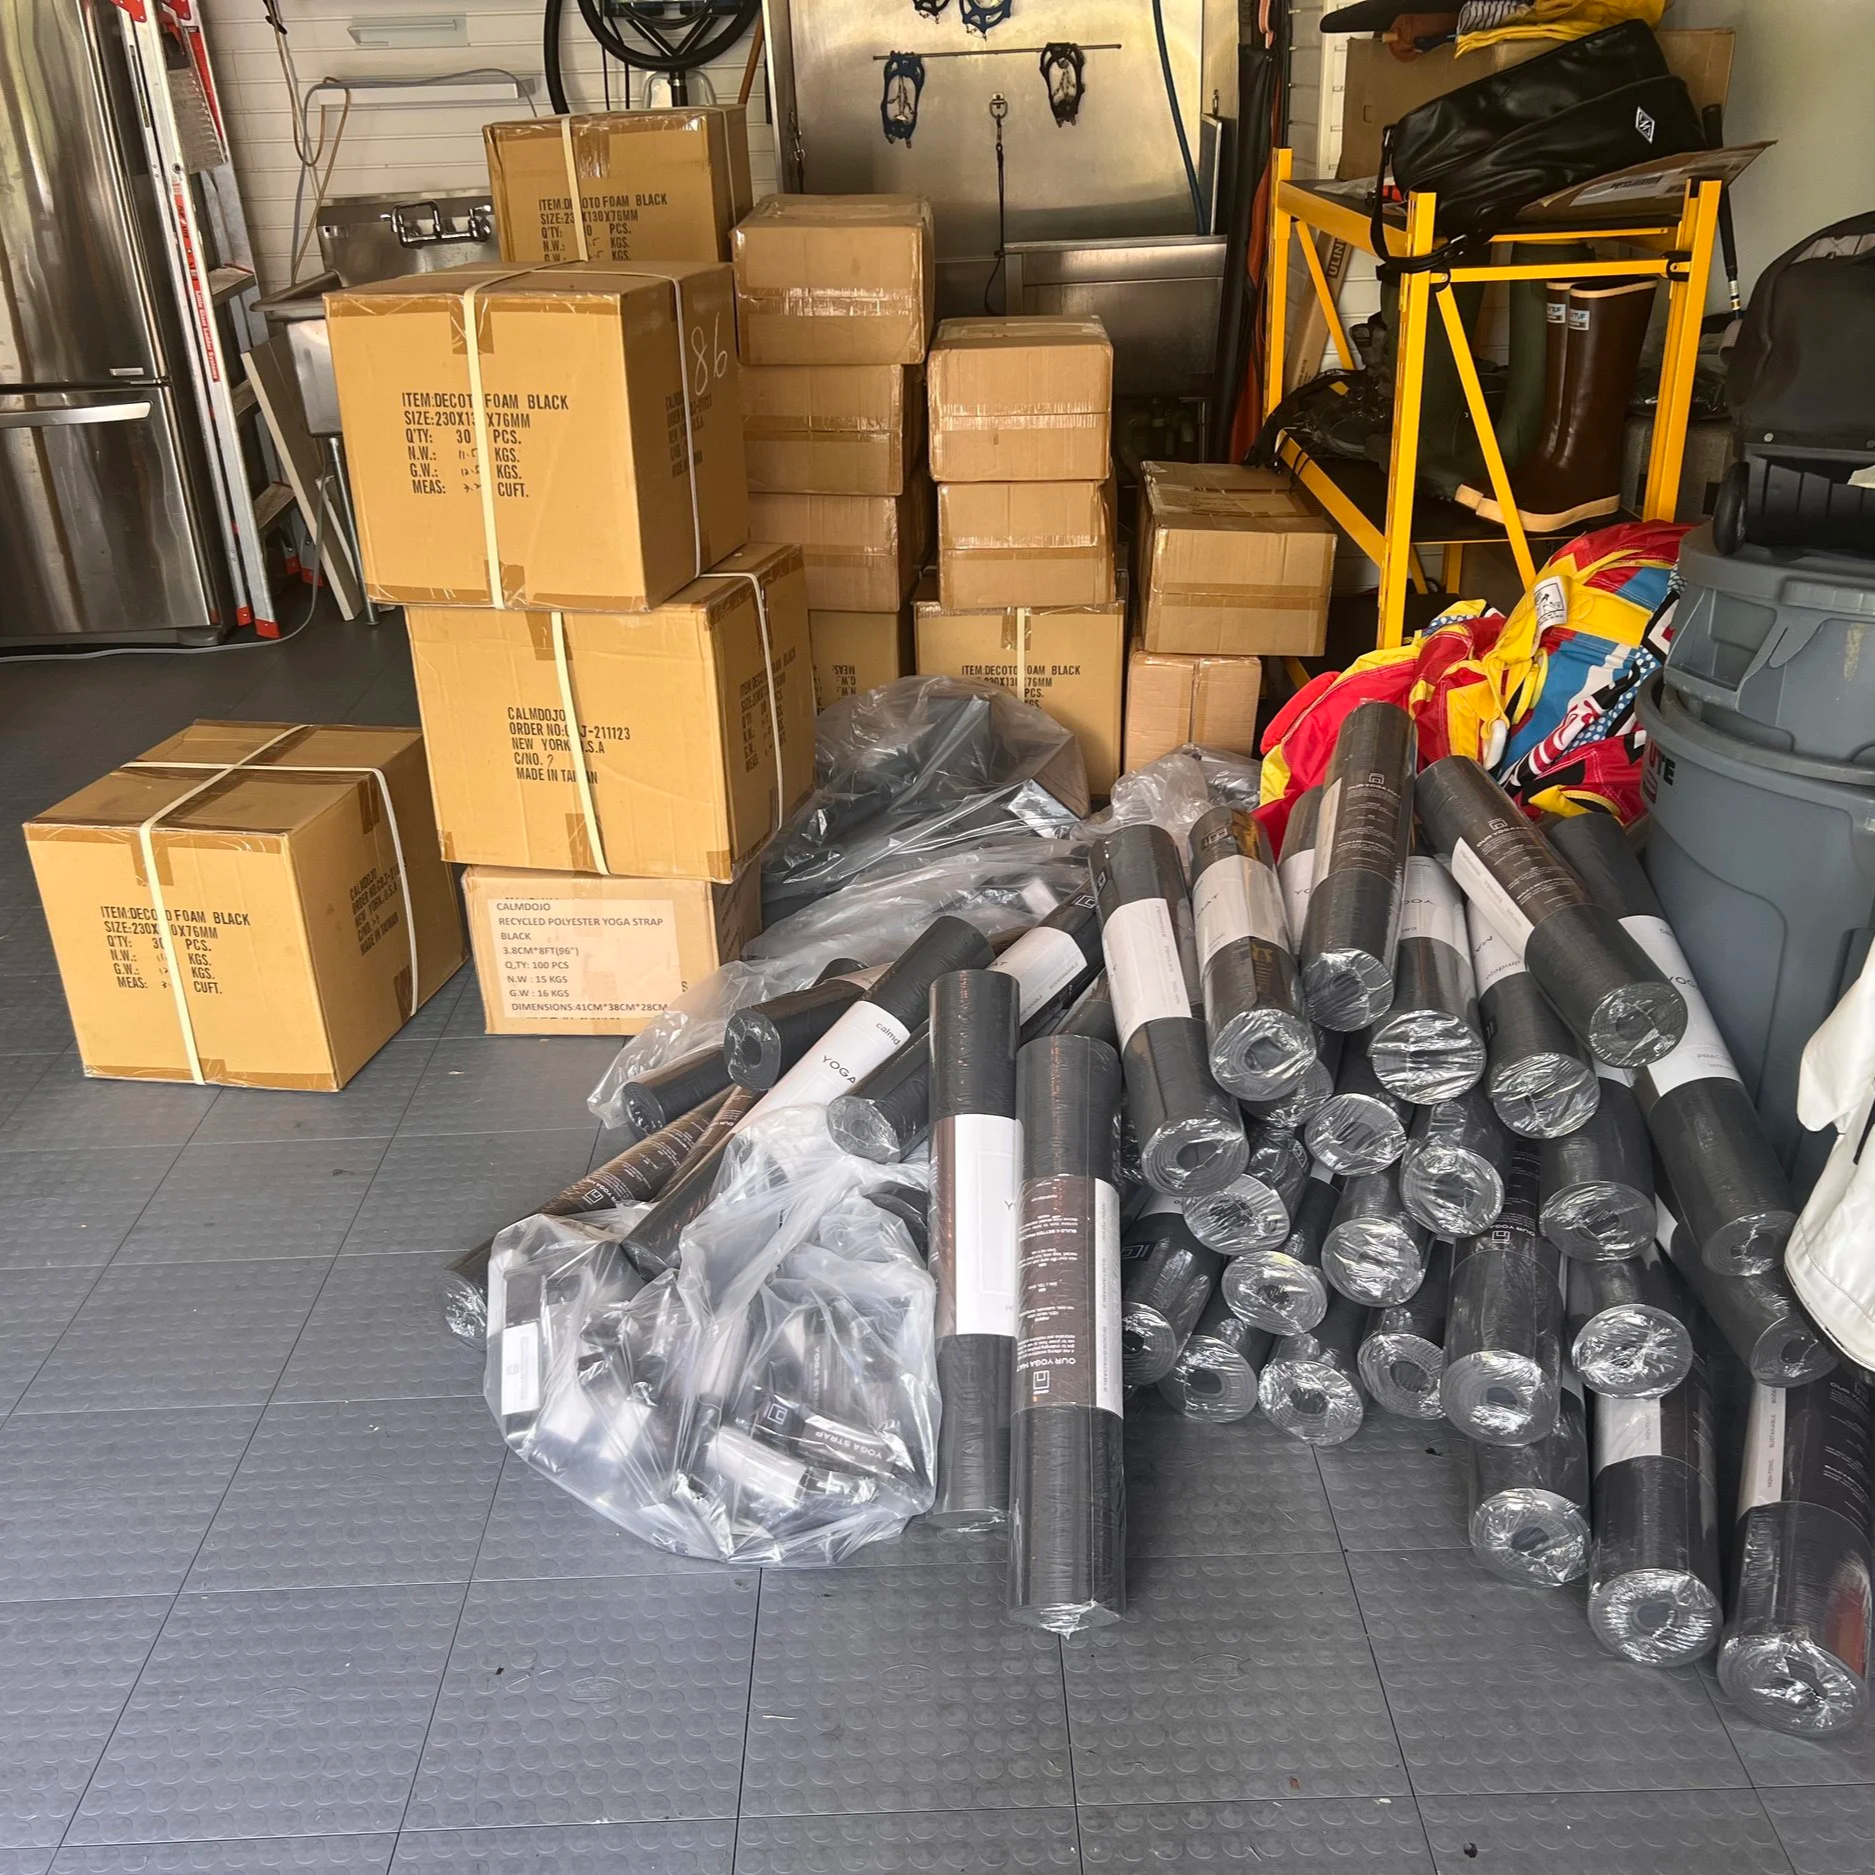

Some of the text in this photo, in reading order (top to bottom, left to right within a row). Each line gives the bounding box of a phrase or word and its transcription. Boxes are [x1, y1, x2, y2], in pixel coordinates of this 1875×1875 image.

[539, 193, 668, 211] ITEM:DOTO FOAM BLACK
[541, 209, 638, 225] SIZE:23X130X76MM
[541, 226, 563, 239] Q'TY:
[609, 222, 632, 235] PCS.
[610, 237, 631, 249] KGS.
[612, 250, 632, 261] KGS.
[691, 311, 728, 396] 86
[402, 392, 569, 410] ITEM:DECOT FOAM BLACK
[404, 411, 531, 428] SIZE:230X13X76MM
[406, 429, 522, 444] Q'TY: 30 PCS.
[408, 446, 437, 460] N.W.:
[495, 447, 520, 462] KGS.
[410, 463, 438, 477] G.W.:
[496, 465, 522, 479] KGS.
[412, 480, 446, 494] MEAS:
[497, 482, 529, 497] CUFT.
[1024, 665, 1045, 676] OAM
[1051, 665, 1081, 676] BLACK
[1024, 688, 1044, 698] PCS.
[508, 706, 566, 722] CALMDOJO
[509, 722, 630, 740] ORDER NO:CJ-211123
[511, 737, 534, 750] NEW
[514, 752, 544, 766] C/NO.
[516, 767, 598, 784] MADE IN TAIAN
[496, 903, 551, 911] CALMDOJO
[100, 905, 251, 926] ITEM:DECOO FOAM BLACK
[498, 918, 664, 926] RECYCLED POLYESTER YOGA STRAP
[104, 921, 218, 939] SIZE:230X0X76MM
[500, 932, 531, 940] BLACK
[107, 935, 132, 948] Q'TY:
[185, 939, 212, 951] PCS.
[110, 949, 137, 961] N.W.:
[187, 953, 212, 966] KGS.
[532, 961, 549, 969] 100
[552, 961, 569, 969] PCS
[114, 963, 140, 975] G.W.:
[191, 967, 215, 980] KGS.
[117, 976, 148, 989] MEAS:
[193, 981, 223, 995] CUFT.
[536, 976, 547, 984] 15
[550, 976, 568, 984] KGS
[538, 990, 549, 998] 16
[551, 990, 570, 998] KGS
[876, 1022, 902, 1046] calmd
[823, 1054, 857, 1084] YOGA
[1030, 1359, 1054, 1367] YOGA
[815, 1431, 882, 1459] YOGA STRAP
